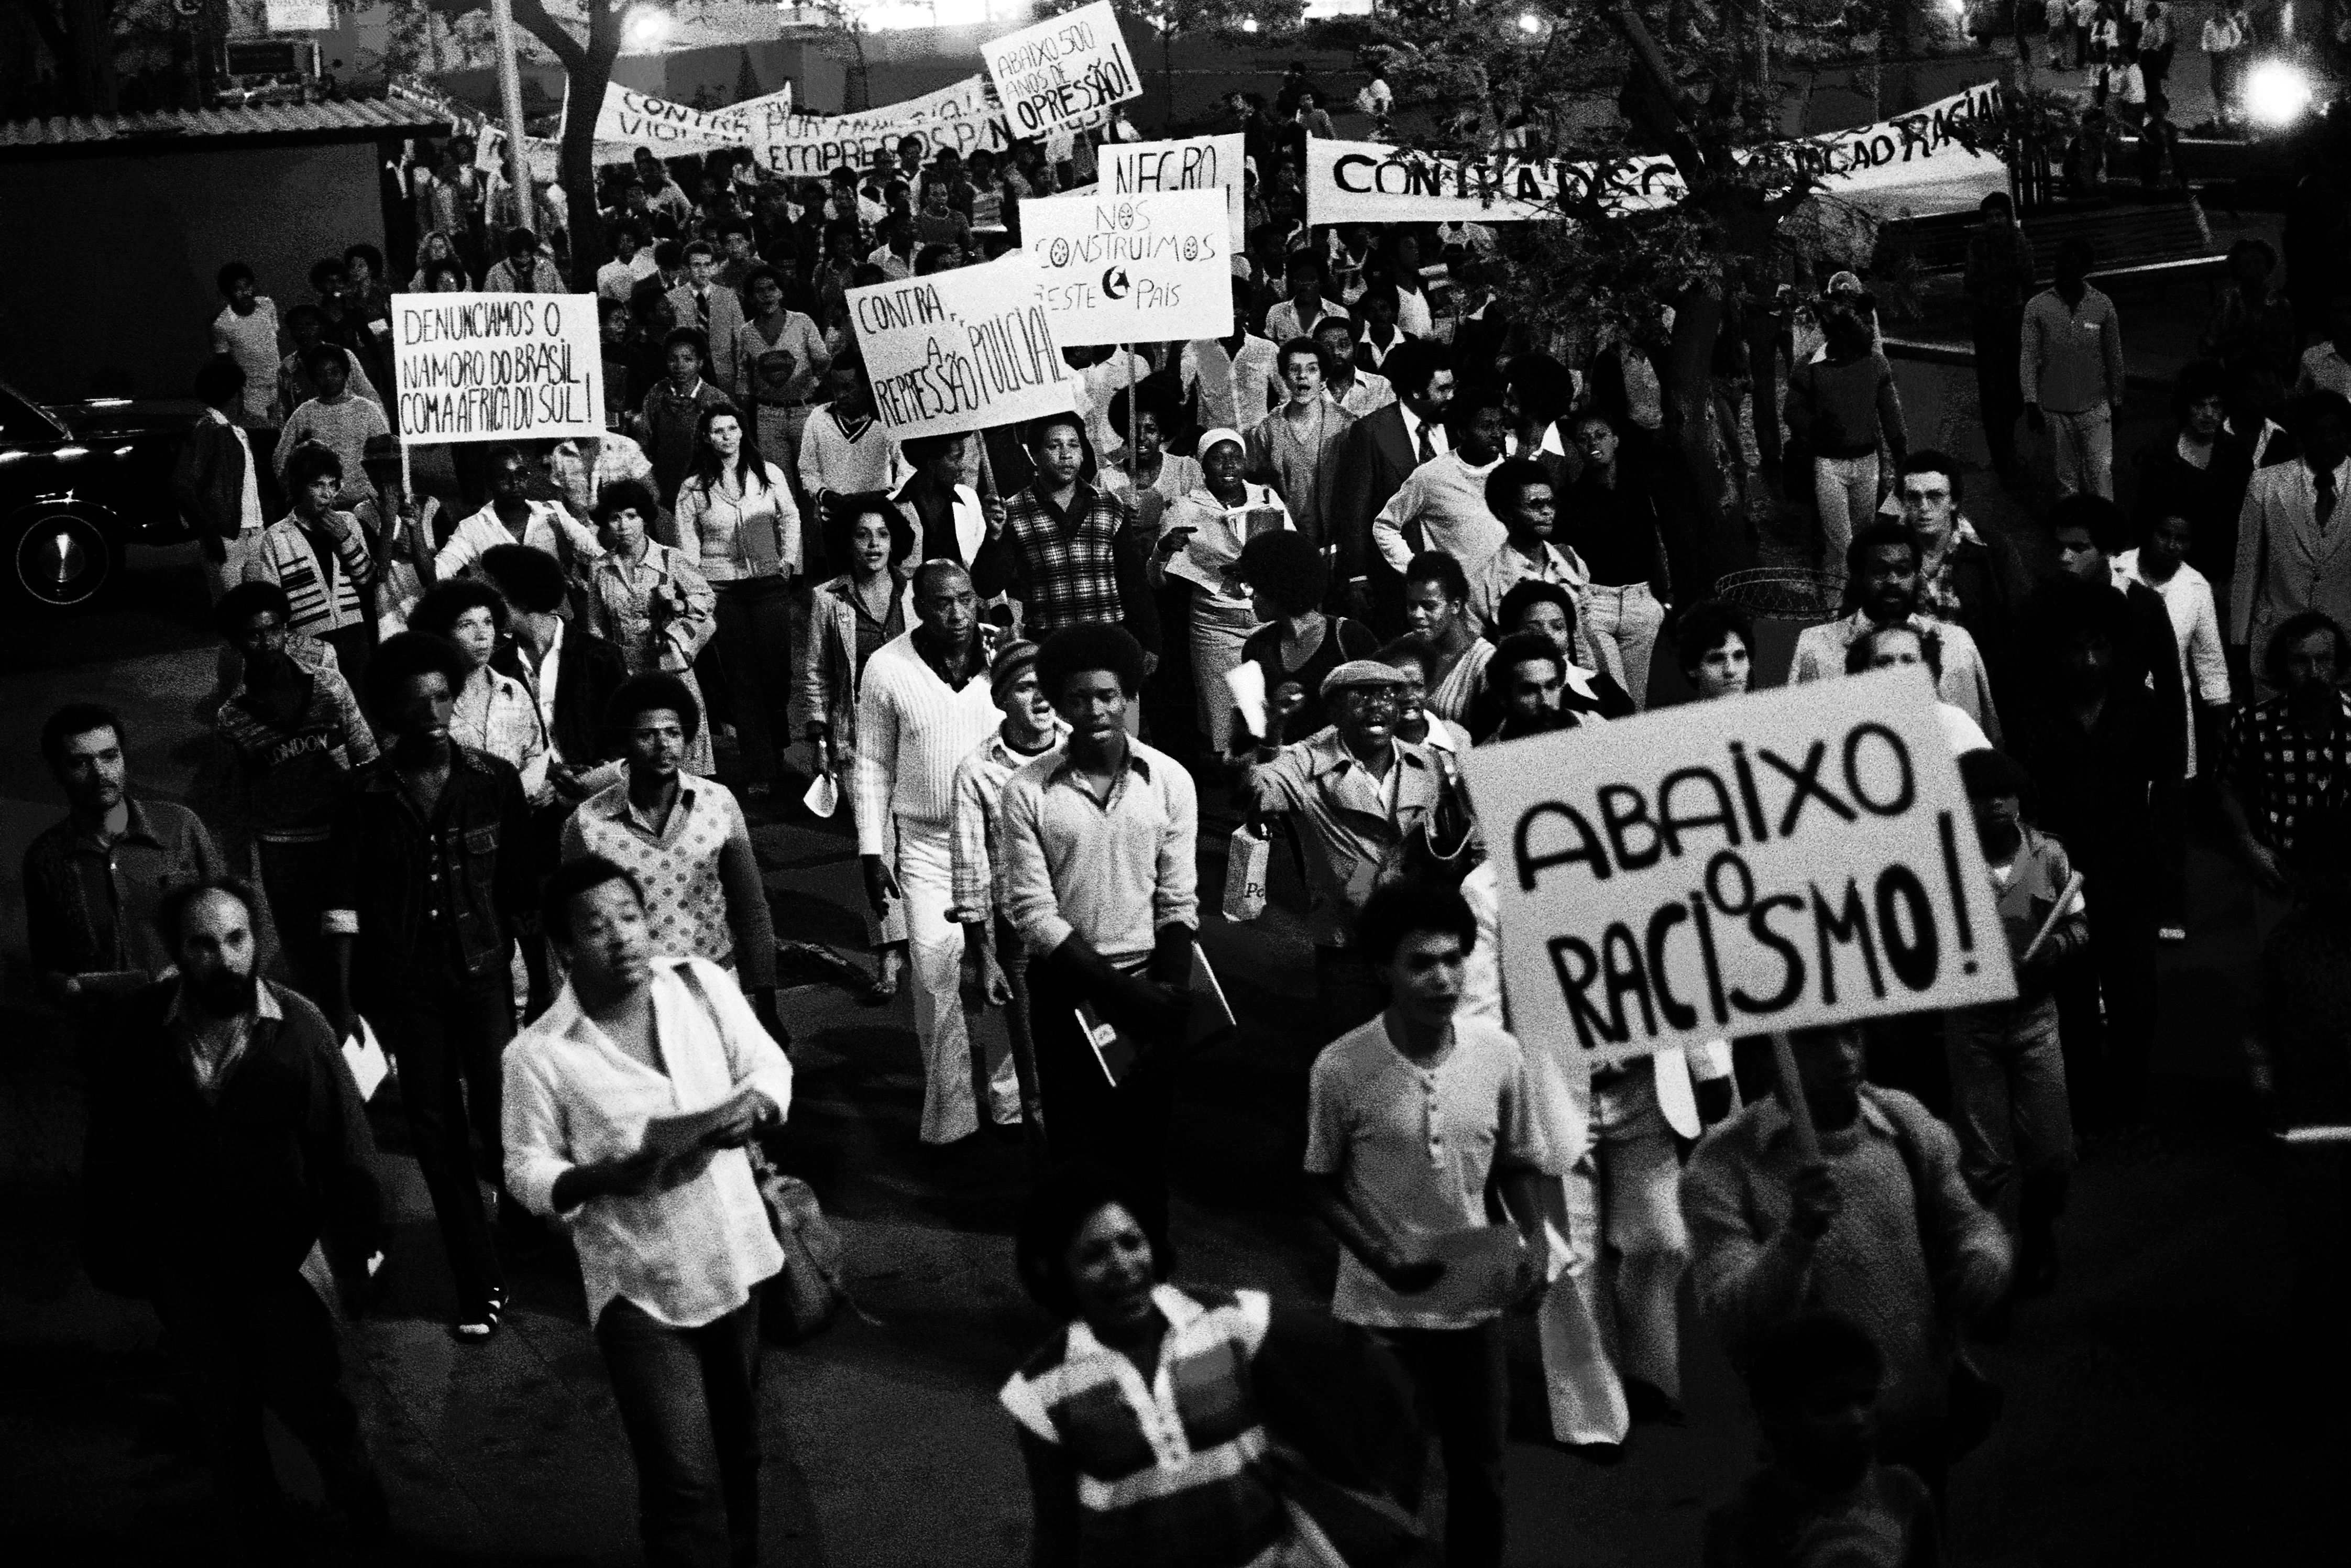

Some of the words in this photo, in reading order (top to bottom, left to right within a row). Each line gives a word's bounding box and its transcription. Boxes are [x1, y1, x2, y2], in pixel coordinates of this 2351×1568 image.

[998, 37, 1059, 79] ABAIXO
[1059, 21, 1095, 55] 500
[1005, 69, 1048, 102] ANOS
[1050, 61, 1071, 86] DE
[1017, 42, 1134, 130] OPRESSÃO!
[1116, 145, 1217, 194] NEGRO
[404, 300, 534, 346] DENUNCIAMOS
[544, 302, 561, 337] O
[858, 283, 944, 334] CONTRA
[403, 350, 485, 389] NAMORO
[490, 349, 512, 386] DO
[874, 350, 979, 429] REPRESSÃO
[968, 304, 1068, 404] POLICIAL
[927, 336, 943, 367] A
[400, 393, 441, 435] COM
[442, 392, 453, 433] A
[513, 386, 533, 431] DO
[537, 372, 592, 423] SUL!
[1513, 721, 1916, 891] ABAIXO
[1705, 850, 1755, 916] O
[1547, 809, 1980, 1049] RACISMO!
